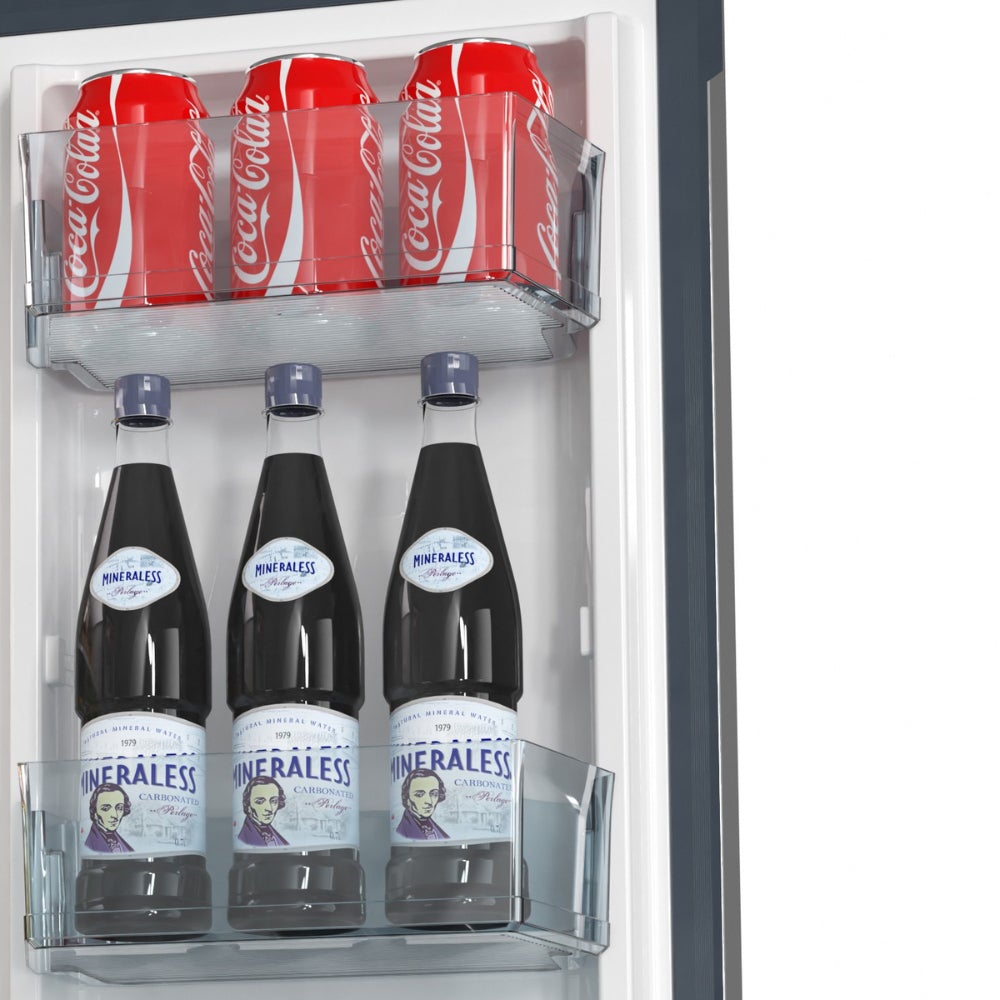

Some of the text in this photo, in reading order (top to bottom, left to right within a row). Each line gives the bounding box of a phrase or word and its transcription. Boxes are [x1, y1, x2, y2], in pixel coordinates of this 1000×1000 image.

[402, 79, 443, 272] Coca-Cola
[232, 94, 270, 285] Coca-Cola
[63, 109, 99, 298] Coca-Cola
[413, 552, 475, 568] MINERALESS
[255, 561, 316, 578] MINERALESS
[102, 570, 162, 586] MINERALESS
[275, 731, 291, 739] 1979
[435, 723, 451, 731] 1979
[121, 739, 136, 747] 1979
